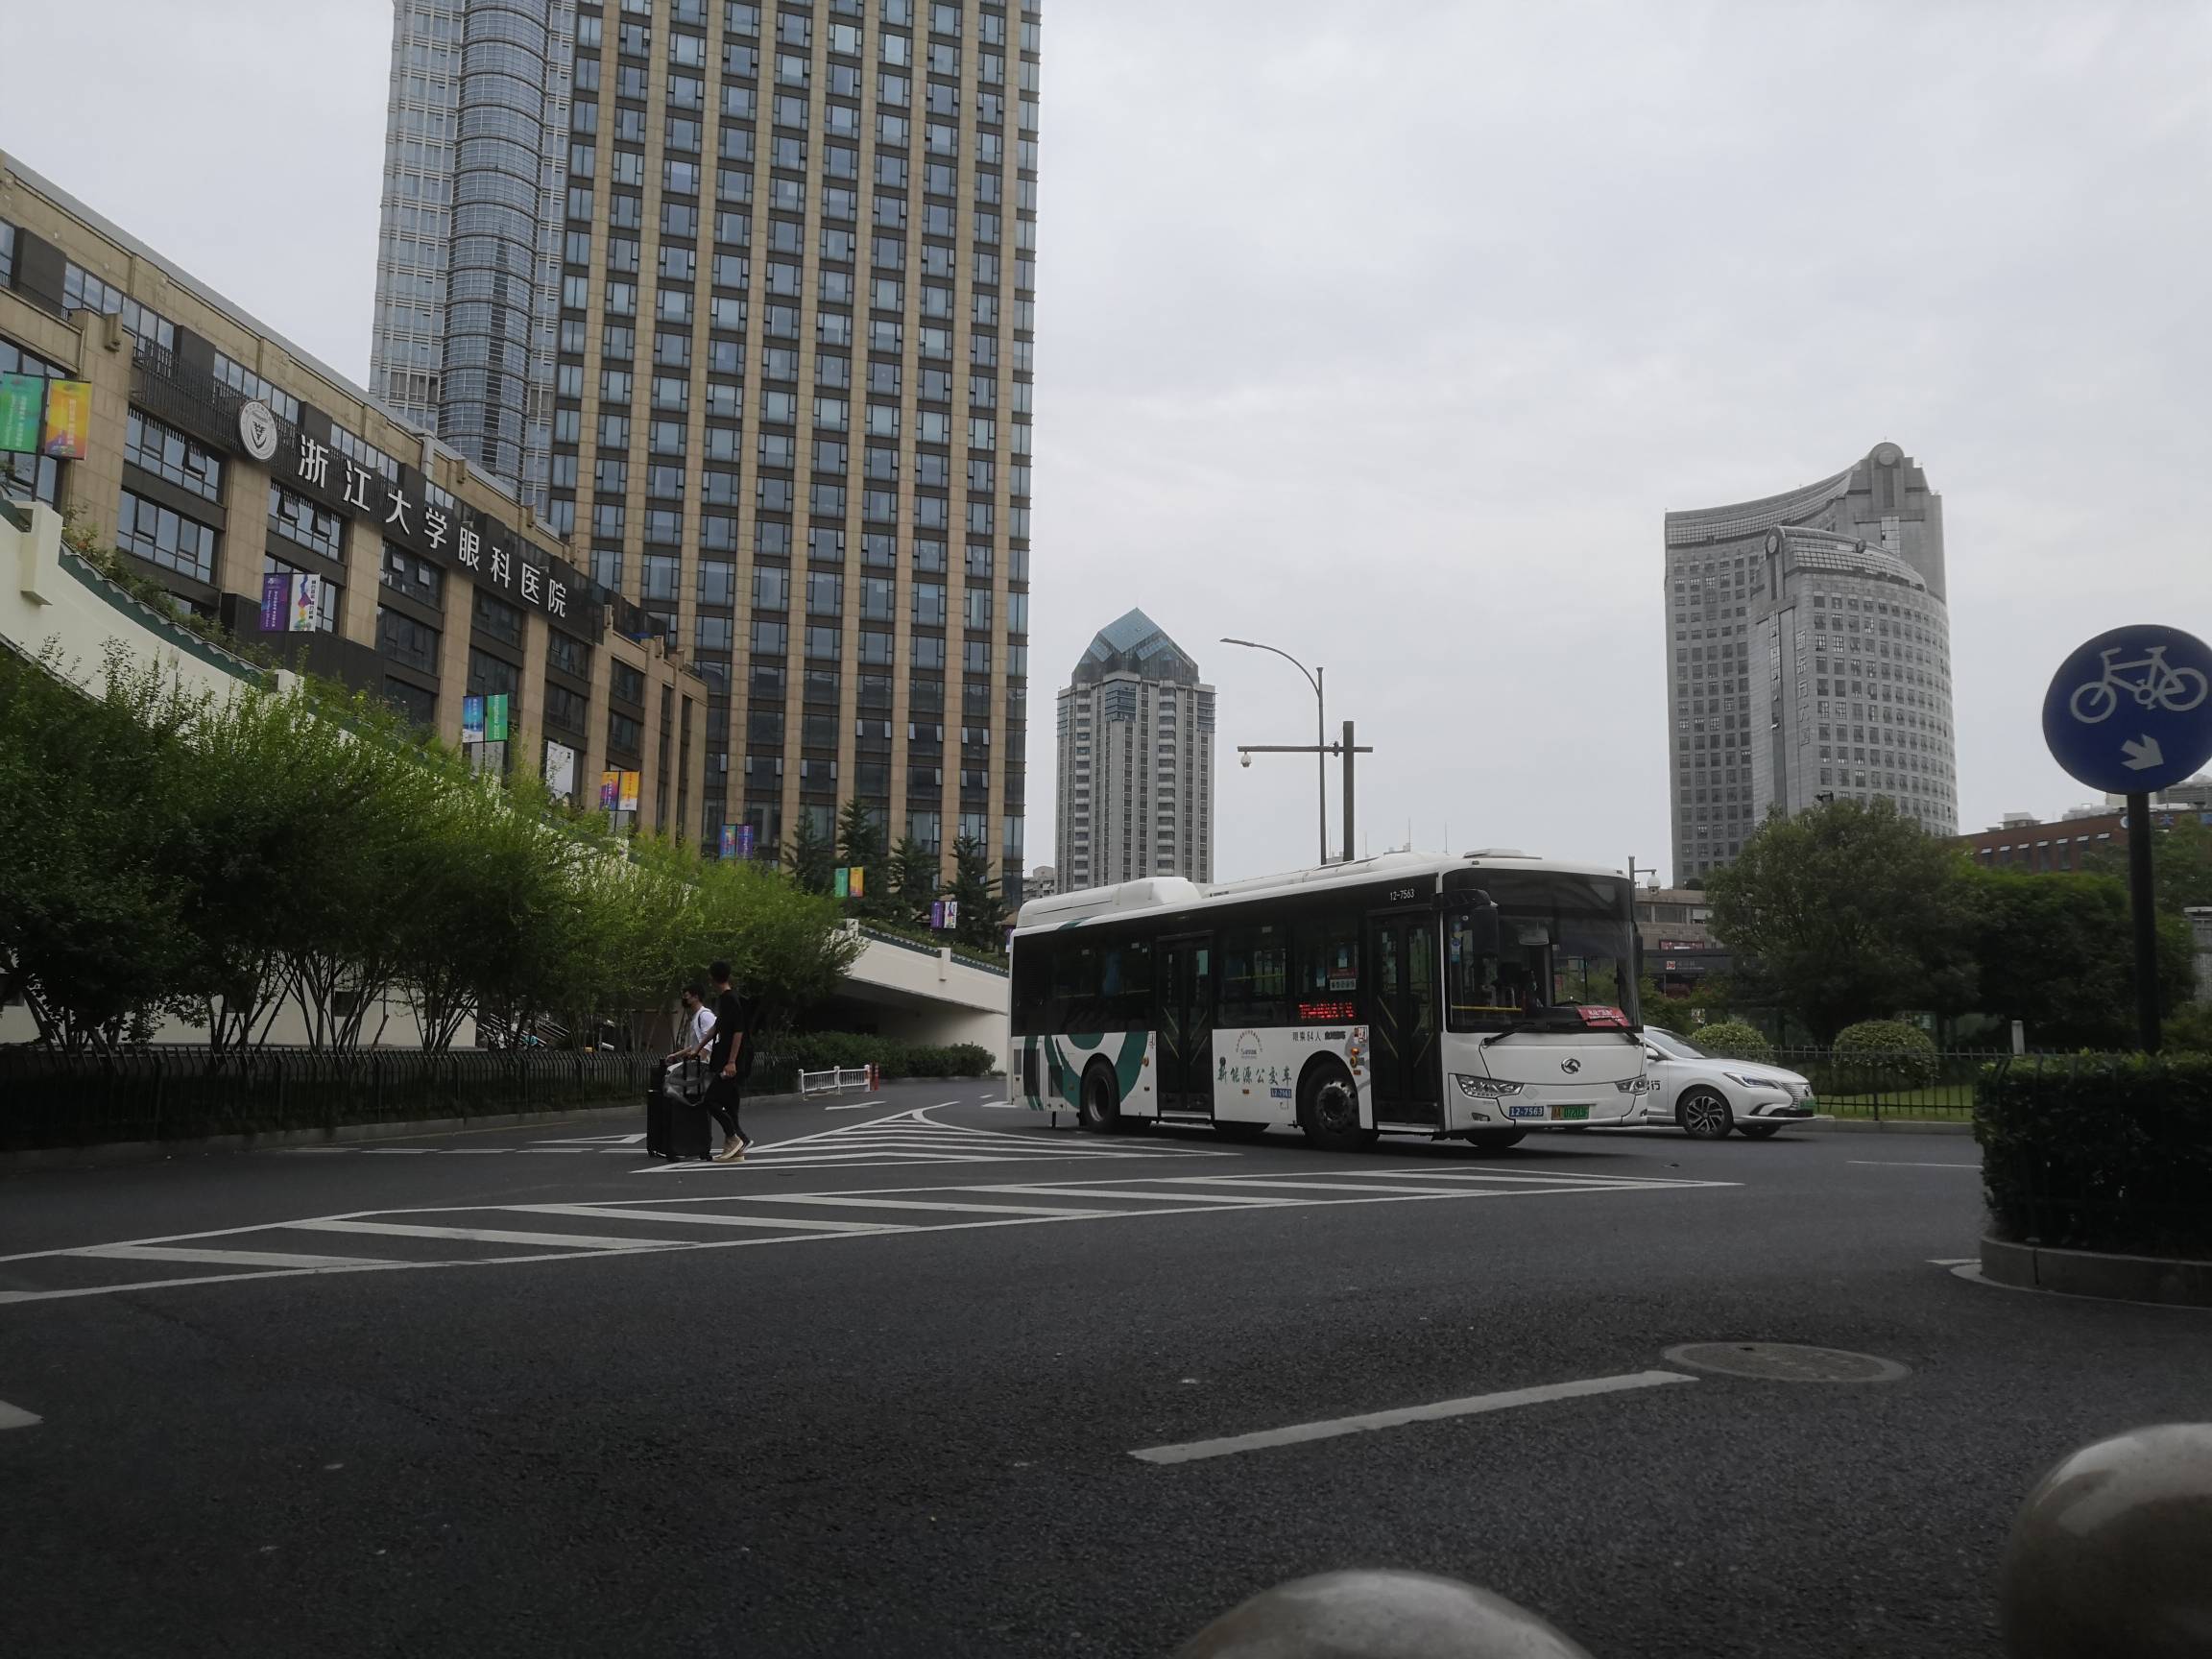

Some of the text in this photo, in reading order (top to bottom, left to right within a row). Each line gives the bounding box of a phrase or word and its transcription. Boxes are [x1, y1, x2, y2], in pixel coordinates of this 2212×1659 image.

[298, 434, 567, 618] 浙江大学眼科医院
[1389, 888, 1415, 902] 12-7563
[1509, 1107, 1544, 1117] 12-7563
